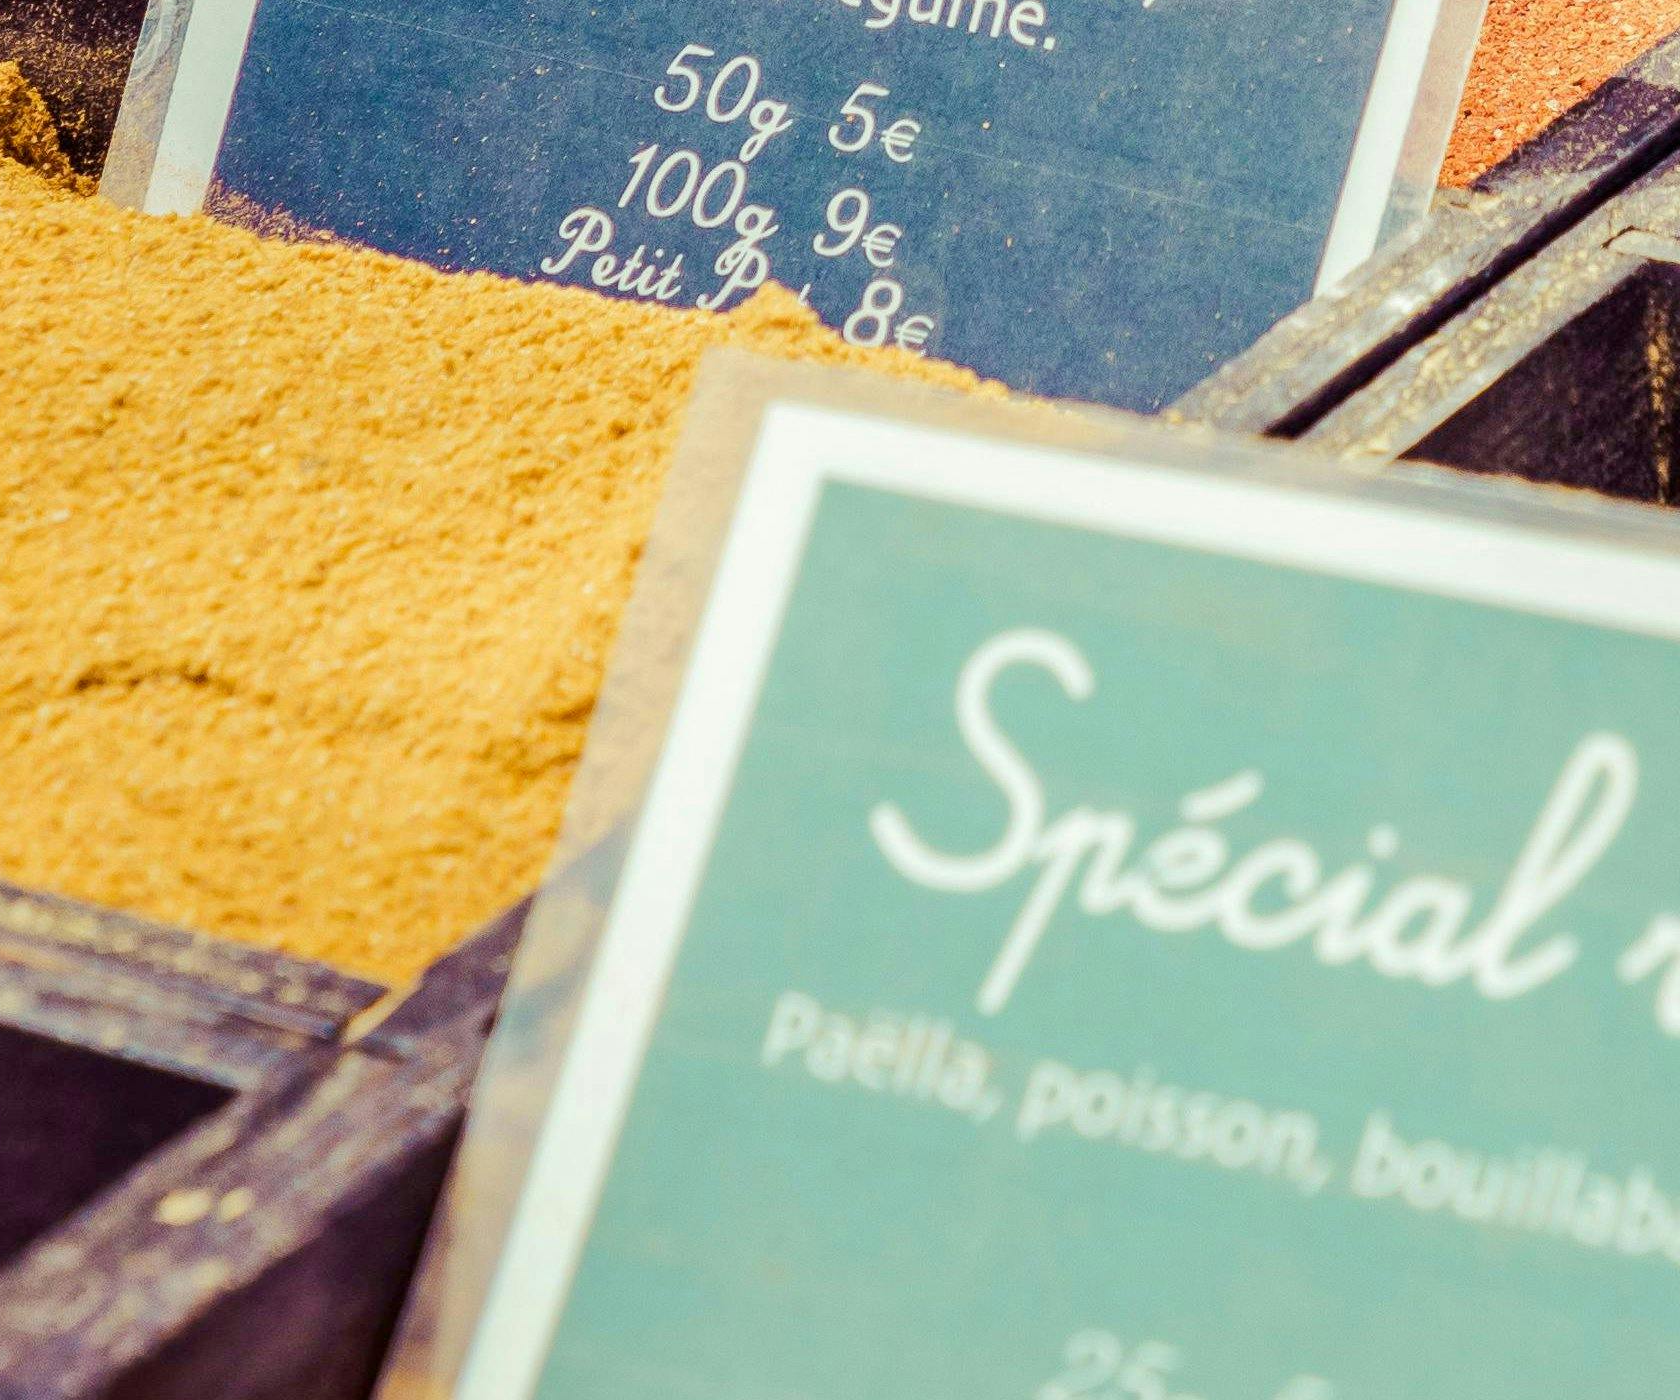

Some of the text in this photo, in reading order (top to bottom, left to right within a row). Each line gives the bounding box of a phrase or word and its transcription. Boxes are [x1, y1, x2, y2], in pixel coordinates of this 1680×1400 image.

[653, 43, 922, 164] 50g 5€
[617, 143, 903, 269] 100g 9€
[541, 206, 684, 300] Petit
[843, 278, 936, 356] 8€
[867, 626, 1641, 1015] Spécial
[760, 990, 1002, 1124] Paëlla,
[1016, 1055, 1332, 1195] poisson,
[1032, 1326, 1190, 1400] 25
